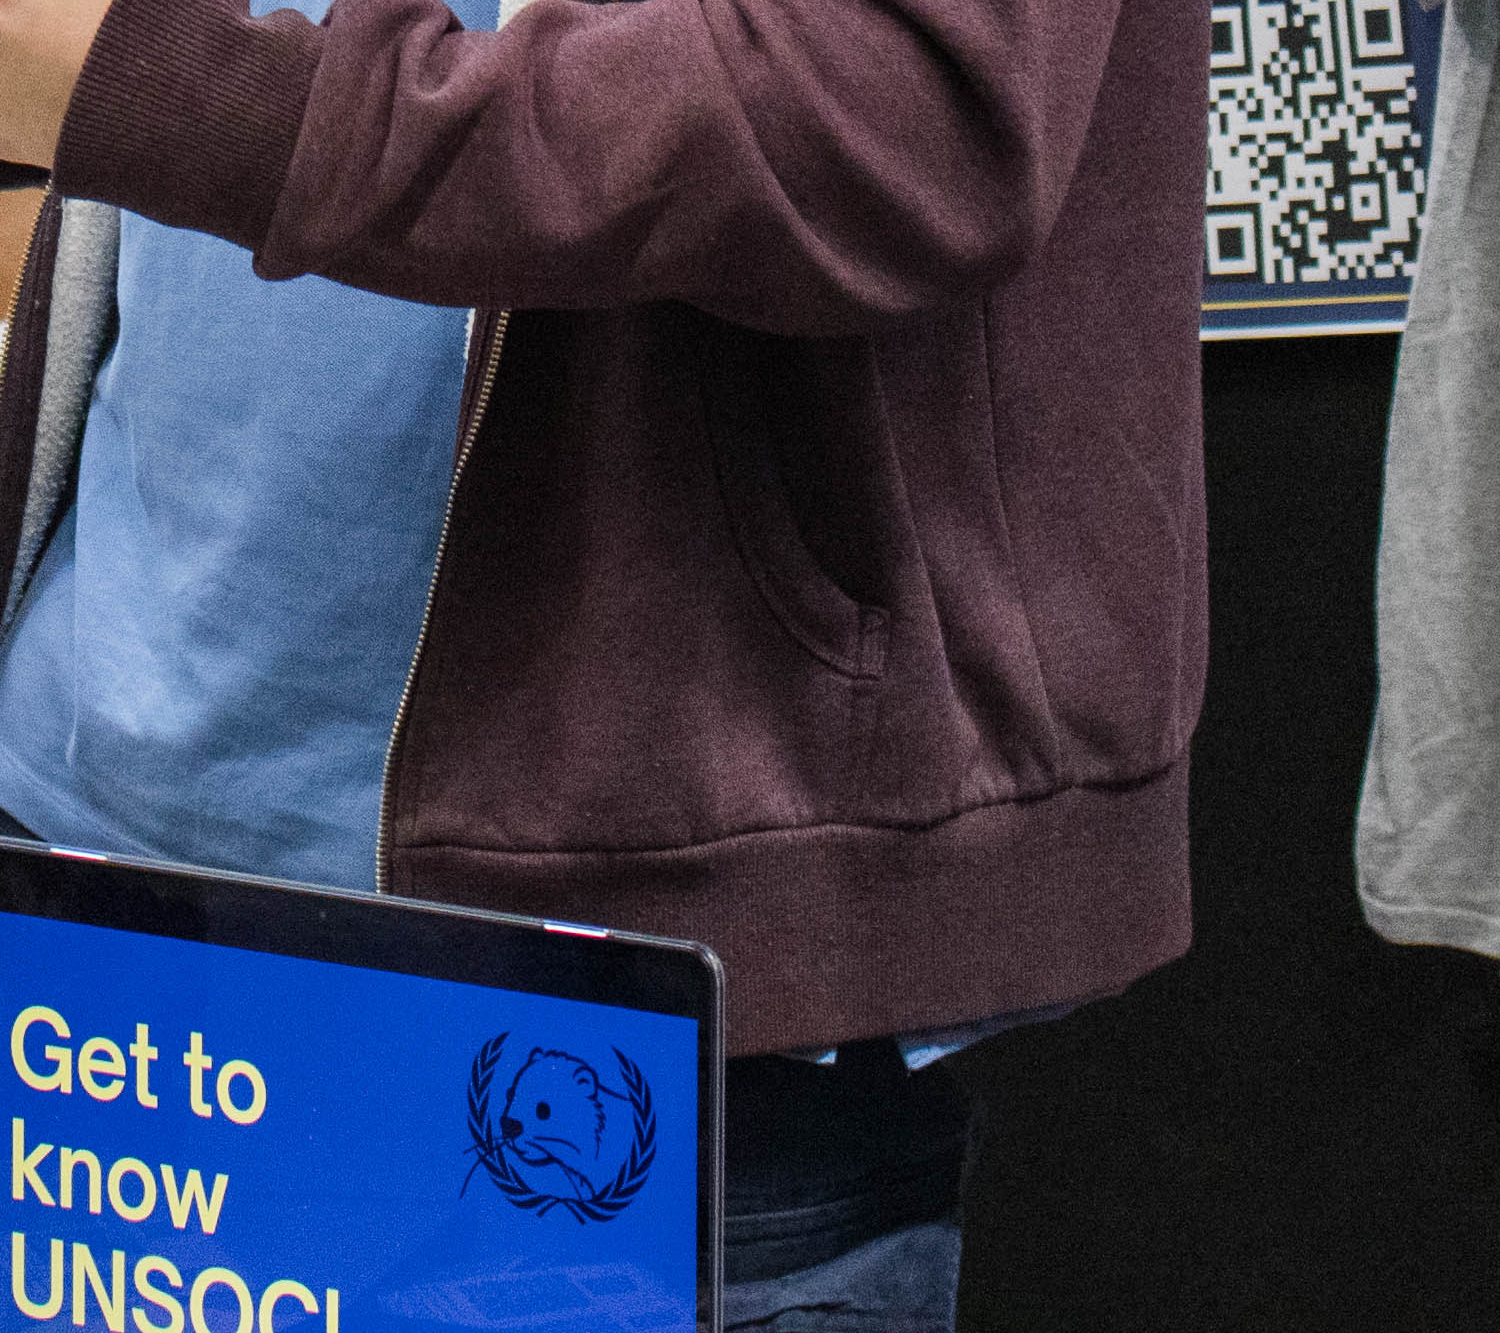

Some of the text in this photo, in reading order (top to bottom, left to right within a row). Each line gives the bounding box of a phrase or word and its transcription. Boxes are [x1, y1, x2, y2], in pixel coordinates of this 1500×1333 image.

[10, 1004, 268, 1127] Get to
[11, 1116, 230, 1236] know
